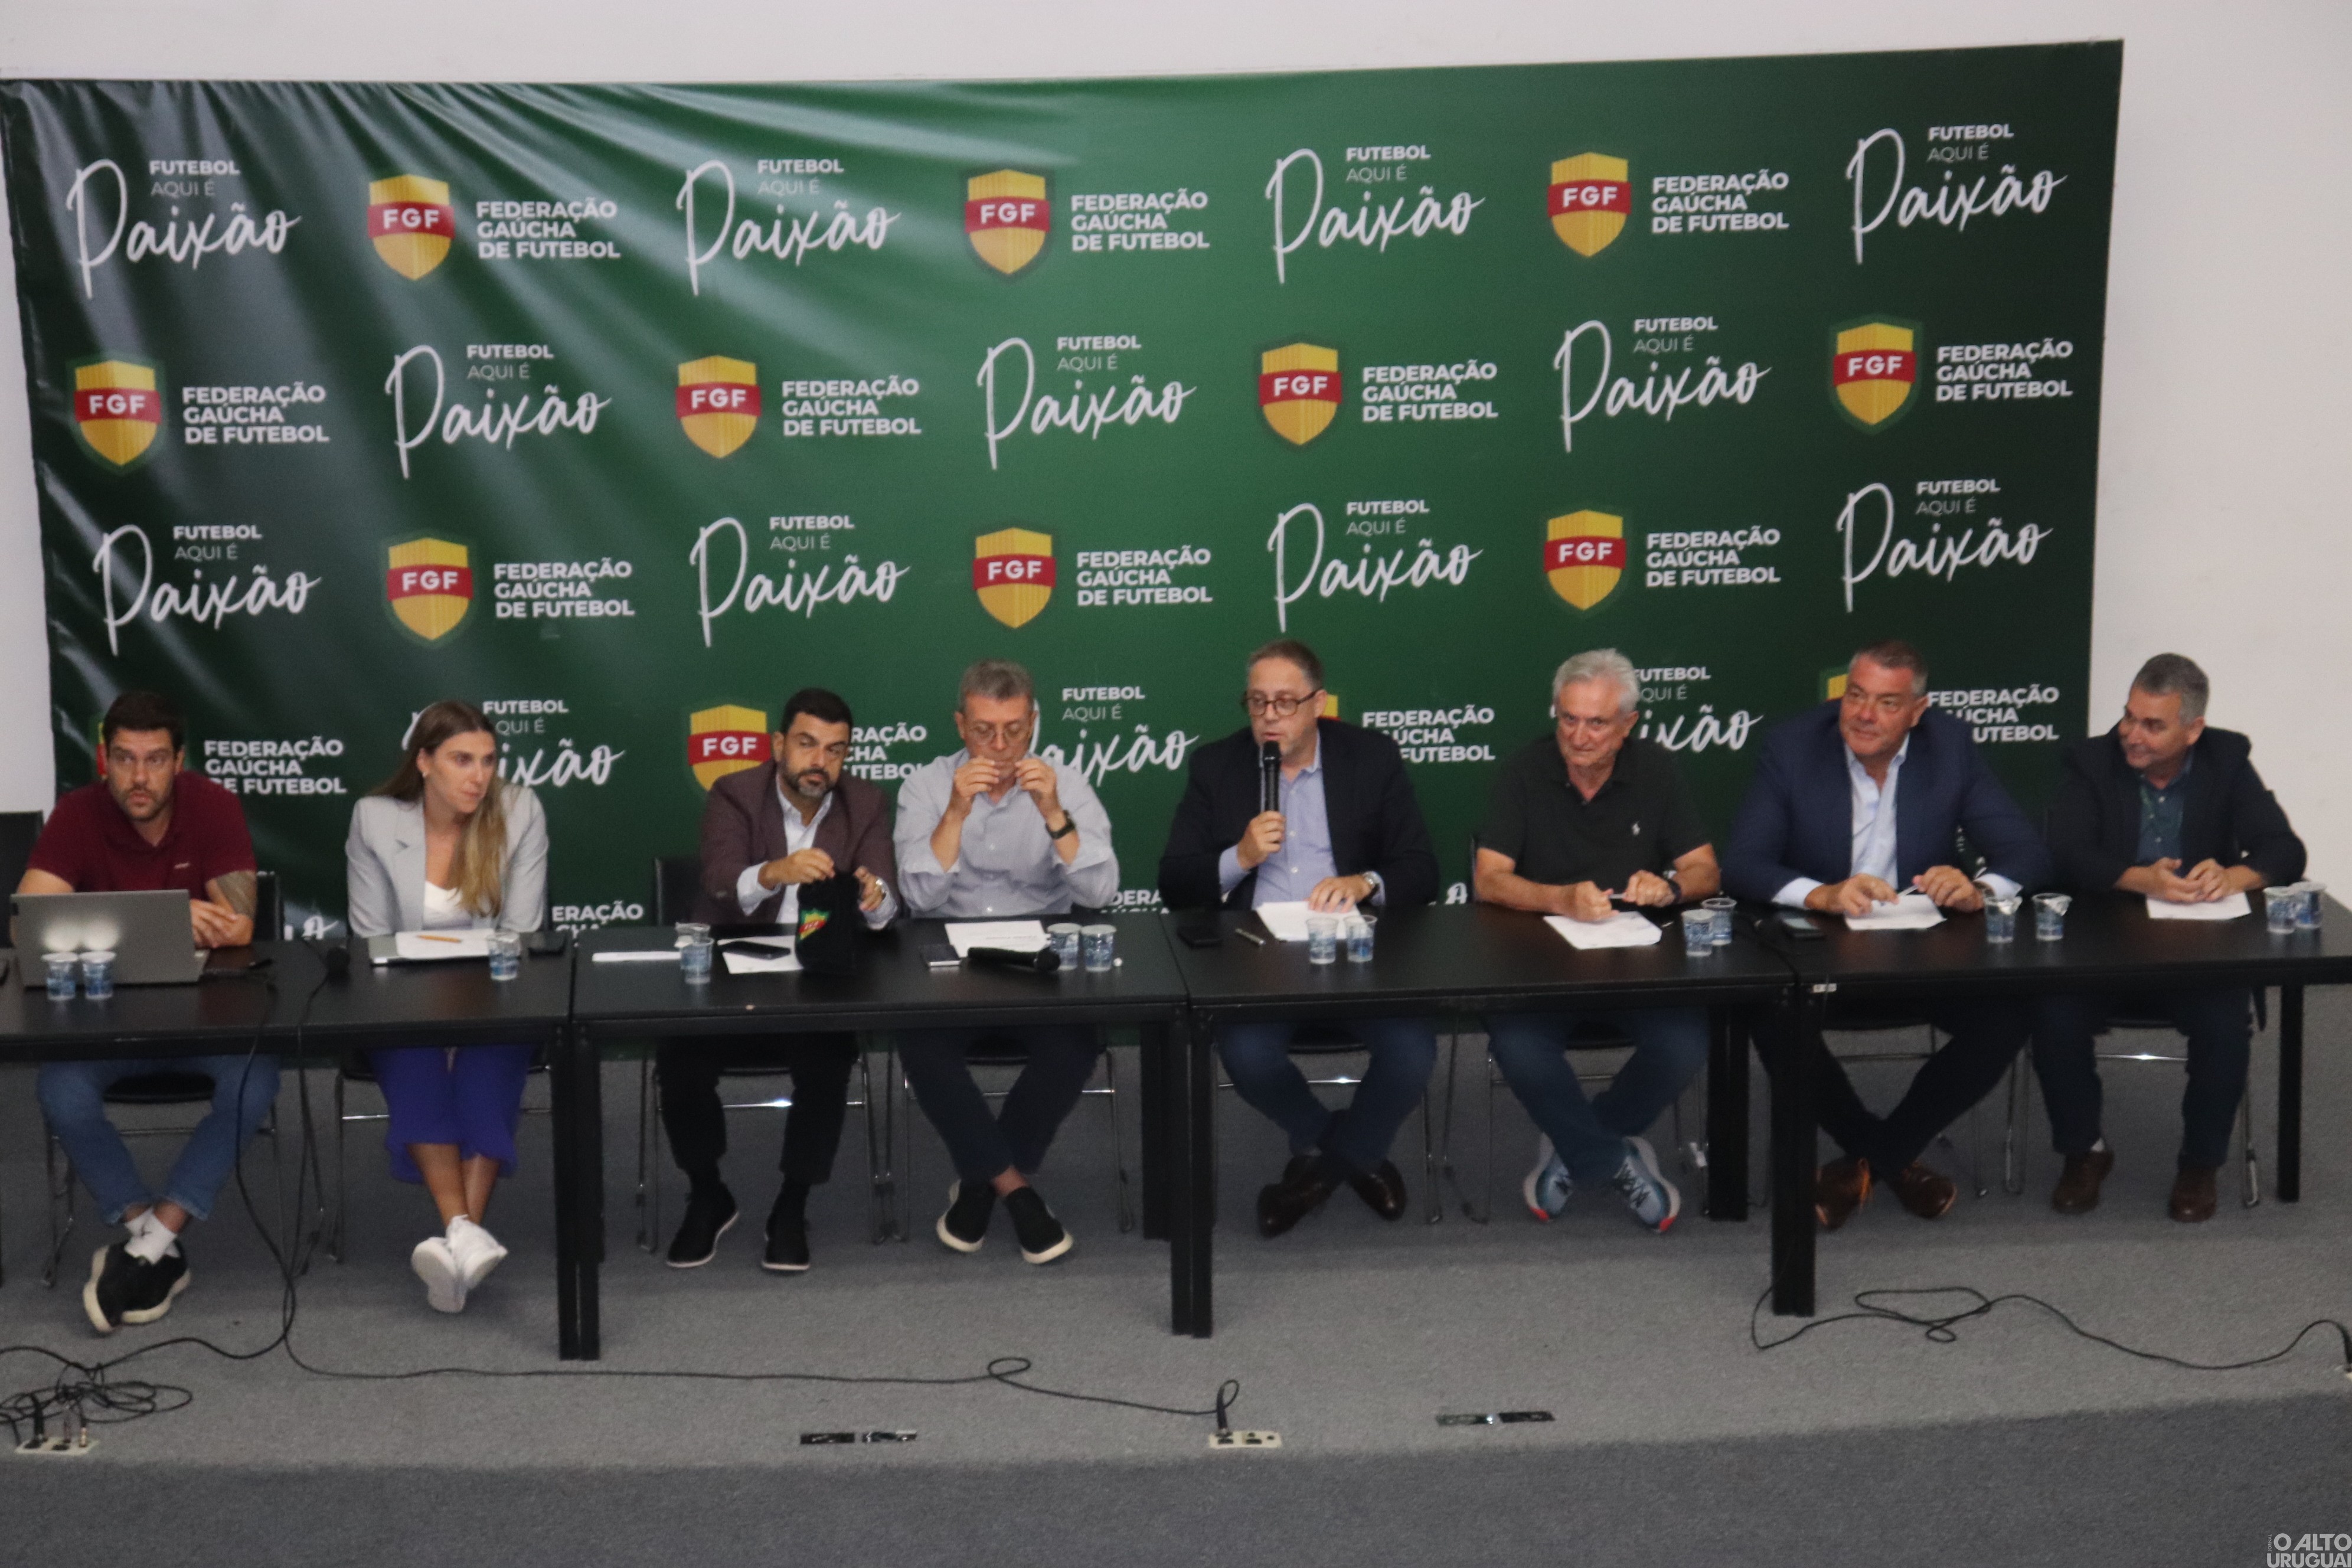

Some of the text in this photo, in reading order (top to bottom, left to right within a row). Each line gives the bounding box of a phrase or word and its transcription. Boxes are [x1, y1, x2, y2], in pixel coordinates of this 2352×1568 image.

[1928, 123, 2014, 141] FUTEBOL
[1345, 145, 1431, 162] FUTEBOL
[1927, 142, 1988, 164] AQUI É
[149, 159, 240, 177] FUTEBOL
[758, 159, 844, 174] FUTEBOL
[1345, 164, 1406, 184] AQUI É
[151, 179, 215, 197] AQUI É
[757, 178, 819, 195] AQUI É
[1652, 169, 1789, 196] FEDERAÇÃO
[1070, 188, 1208, 213] FEDERAÇÃO
[1563, 185, 1618, 208] FGF
[1651, 193, 1747, 214] GAÚCHA
[1845, 128, 2066, 264] Paixão
[476, 194, 617, 221] FEDERAÇÃO
[981, 202, 1035, 224] FGF
[1265, 148, 1484, 284] Paixão
[67, 158, 301, 299] Paixão
[384, 208, 440, 231] FGF
[478, 218, 576, 239] GAÚCHA
[677, 159, 900, 295] Paixão
[1071, 210, 1168, 232] GAÚCHA
[1652, 212, 1789, 234] DE FUTEBOL
[478, 240, 621, 260] DE FUTEBOL
[1072, 231, 1210, 252] DE FUTEBOL
[1634, 316, 1718, 333] FUTEBOL
[466, 344, 554, 360] FUTEBOL
[1057, 335, 1142, 351] FUTEBOL
[1633, 334, 1693, 355] AQUI É
[1937, 338, 2073, 364] FEDERAÇÃO
[466, 362, 530, 382] AQUI É
[1057, 353, 1118, 371] AQUI É
[1362, 359, 1498, 384] FEDERAÇÃO
[1848, 355, 1903, 377] FGF
[1936, 360, 2032, 383] GAÚCHA
[182, 381, 326, 408] FEDERAÇÃO
[782, 374, 920, 401] FEDERAÇÃO
[1273, 375, 1328, 397] FGF
[1362, 381, 1457, 403] GAÚCHA
[1553, 320, 1770, 453] Paixão
[1936, 380, 2073, 401] DE FUTEBOL
[89, 395, 146, 416] FGF
[691, 390, 746, 409] FGF
[782, 396, 878, 417] GAÚCHA
[976, 337, 1196, 470] Paixão
[184, 402, 283, 424] GAÚCHA
[384, 343, 612, 479] Paixão
[1363, 401, 1498, 422] DE FUTEBOL
[185, 424, 330, 444] DE FUTEBOL
[783, 417, 922, 437] DE FUTEBOL
[1916, 479, 2001, 495] FUTEBOL
[1346, 499, 1430, 515] FUTEBOL
[1915, 496, 1975, 517] AQUI É
[173, 524, 262, 540] FUTEBOL
[769, 515, 855, 531] FUTEBOL
[1345, 517, 1406, 537] AQUI É
[769, 533, 830, 553] AQUI É
[1647, 525, 1781, 550] FEDERAÇÃO
[1835, 482, 2052, 612] Paixão
[174, 543, 237, 563] AQUI É
[1076, 545, 1211, 568] FEDERAÇÃO
[1559, 541, 1613, 563] FGF
[1646, 548, 1740, 569] GAÚCHA
[494, 557, 633, 582] FEDERAÇÃO
[988, 560, 1042, 581] FGF
[1076, 566, 1170, 587] GAÚCHA
[1266, 502, 1482, 633] Paixão
[1646, 566, 1781, 587] DE FUTEBOL
[93, 524, 322, 655] Paixão
[401, 570, 458, 592] FGF
[494, 580, 592, 599] GAÚCHA
[689, 515, 910, 647] Paixão
[1077, 586, 1213, 606] DE FUTEBOL
[495, 599, 635, 618] DE FUTEBOL
[1062, 686, 1145, 701] FUTEBOL
[1641, 684, 1687, 703] QUI É
[1928, 684, 2060, 708] FEDERAÇÃO
[482, 700, 569, 714] FUTEBOL
[1062, 704, 1122, 723] AQUI É
[1362, 704, 1494, 729] FEDERAÇÃO
[1946, 705, 2019, 724] ÚCHA
[496, 717, 545, 736] QUI É
[851, 721, 927, 746] RAÇÃO
[1382, 726, 1455, 745] ÚCHA
[1972, 724, 2060, 743] UTEBOL
[204, 736, 344, 760] FEDERAÇÃO
[703, 736, 757, 757] FGF
[844, 745, 887, 762] CHA
[205, 756, 303, 776] GAÚCHA
[210, 778, 347, 794] E FUTEBOL
[552, 900, 643, 925] ERAÇÃO
